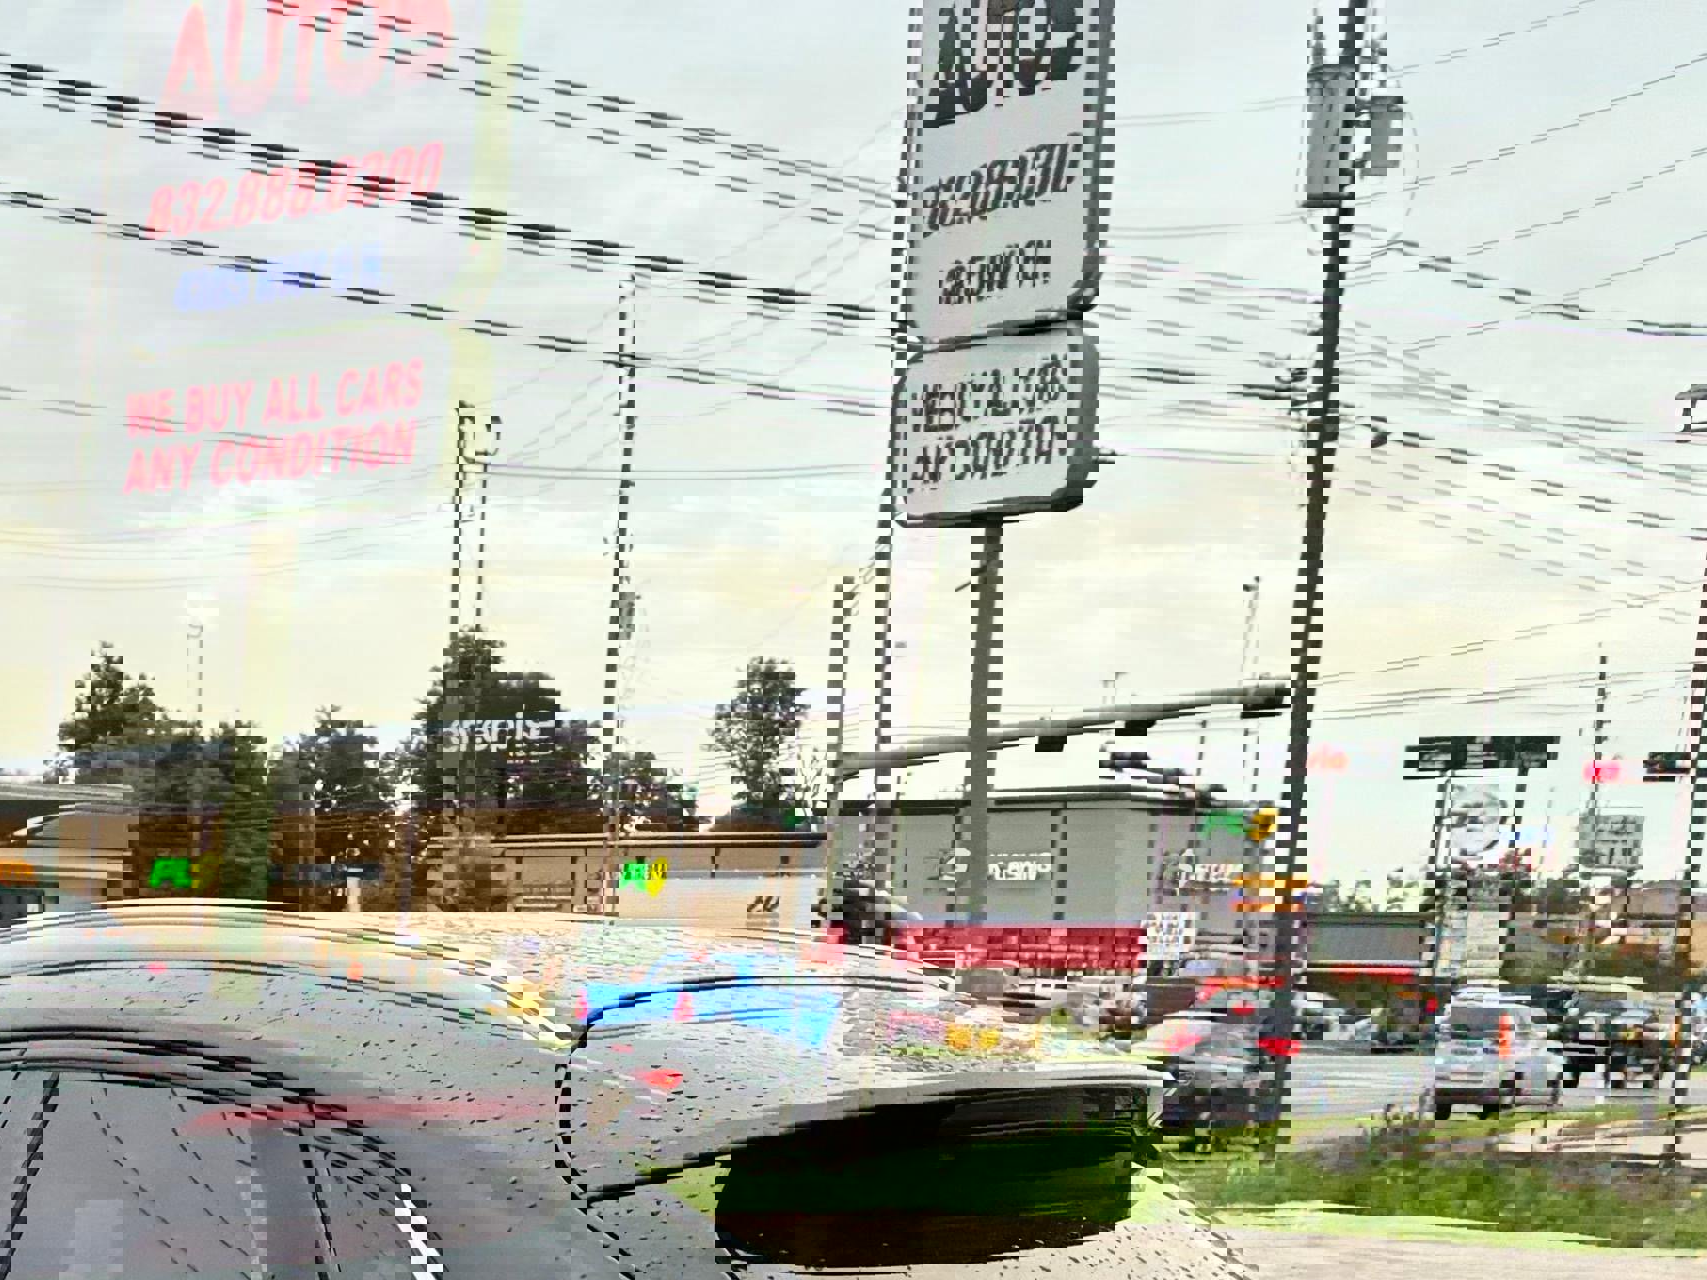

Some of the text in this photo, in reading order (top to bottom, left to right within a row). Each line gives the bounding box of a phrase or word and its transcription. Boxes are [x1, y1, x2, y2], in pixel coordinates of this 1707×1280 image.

[125, 356, 425, 438] WE BUY ALL CARS
[123, 415, 417, 495] ANY CONDITION
